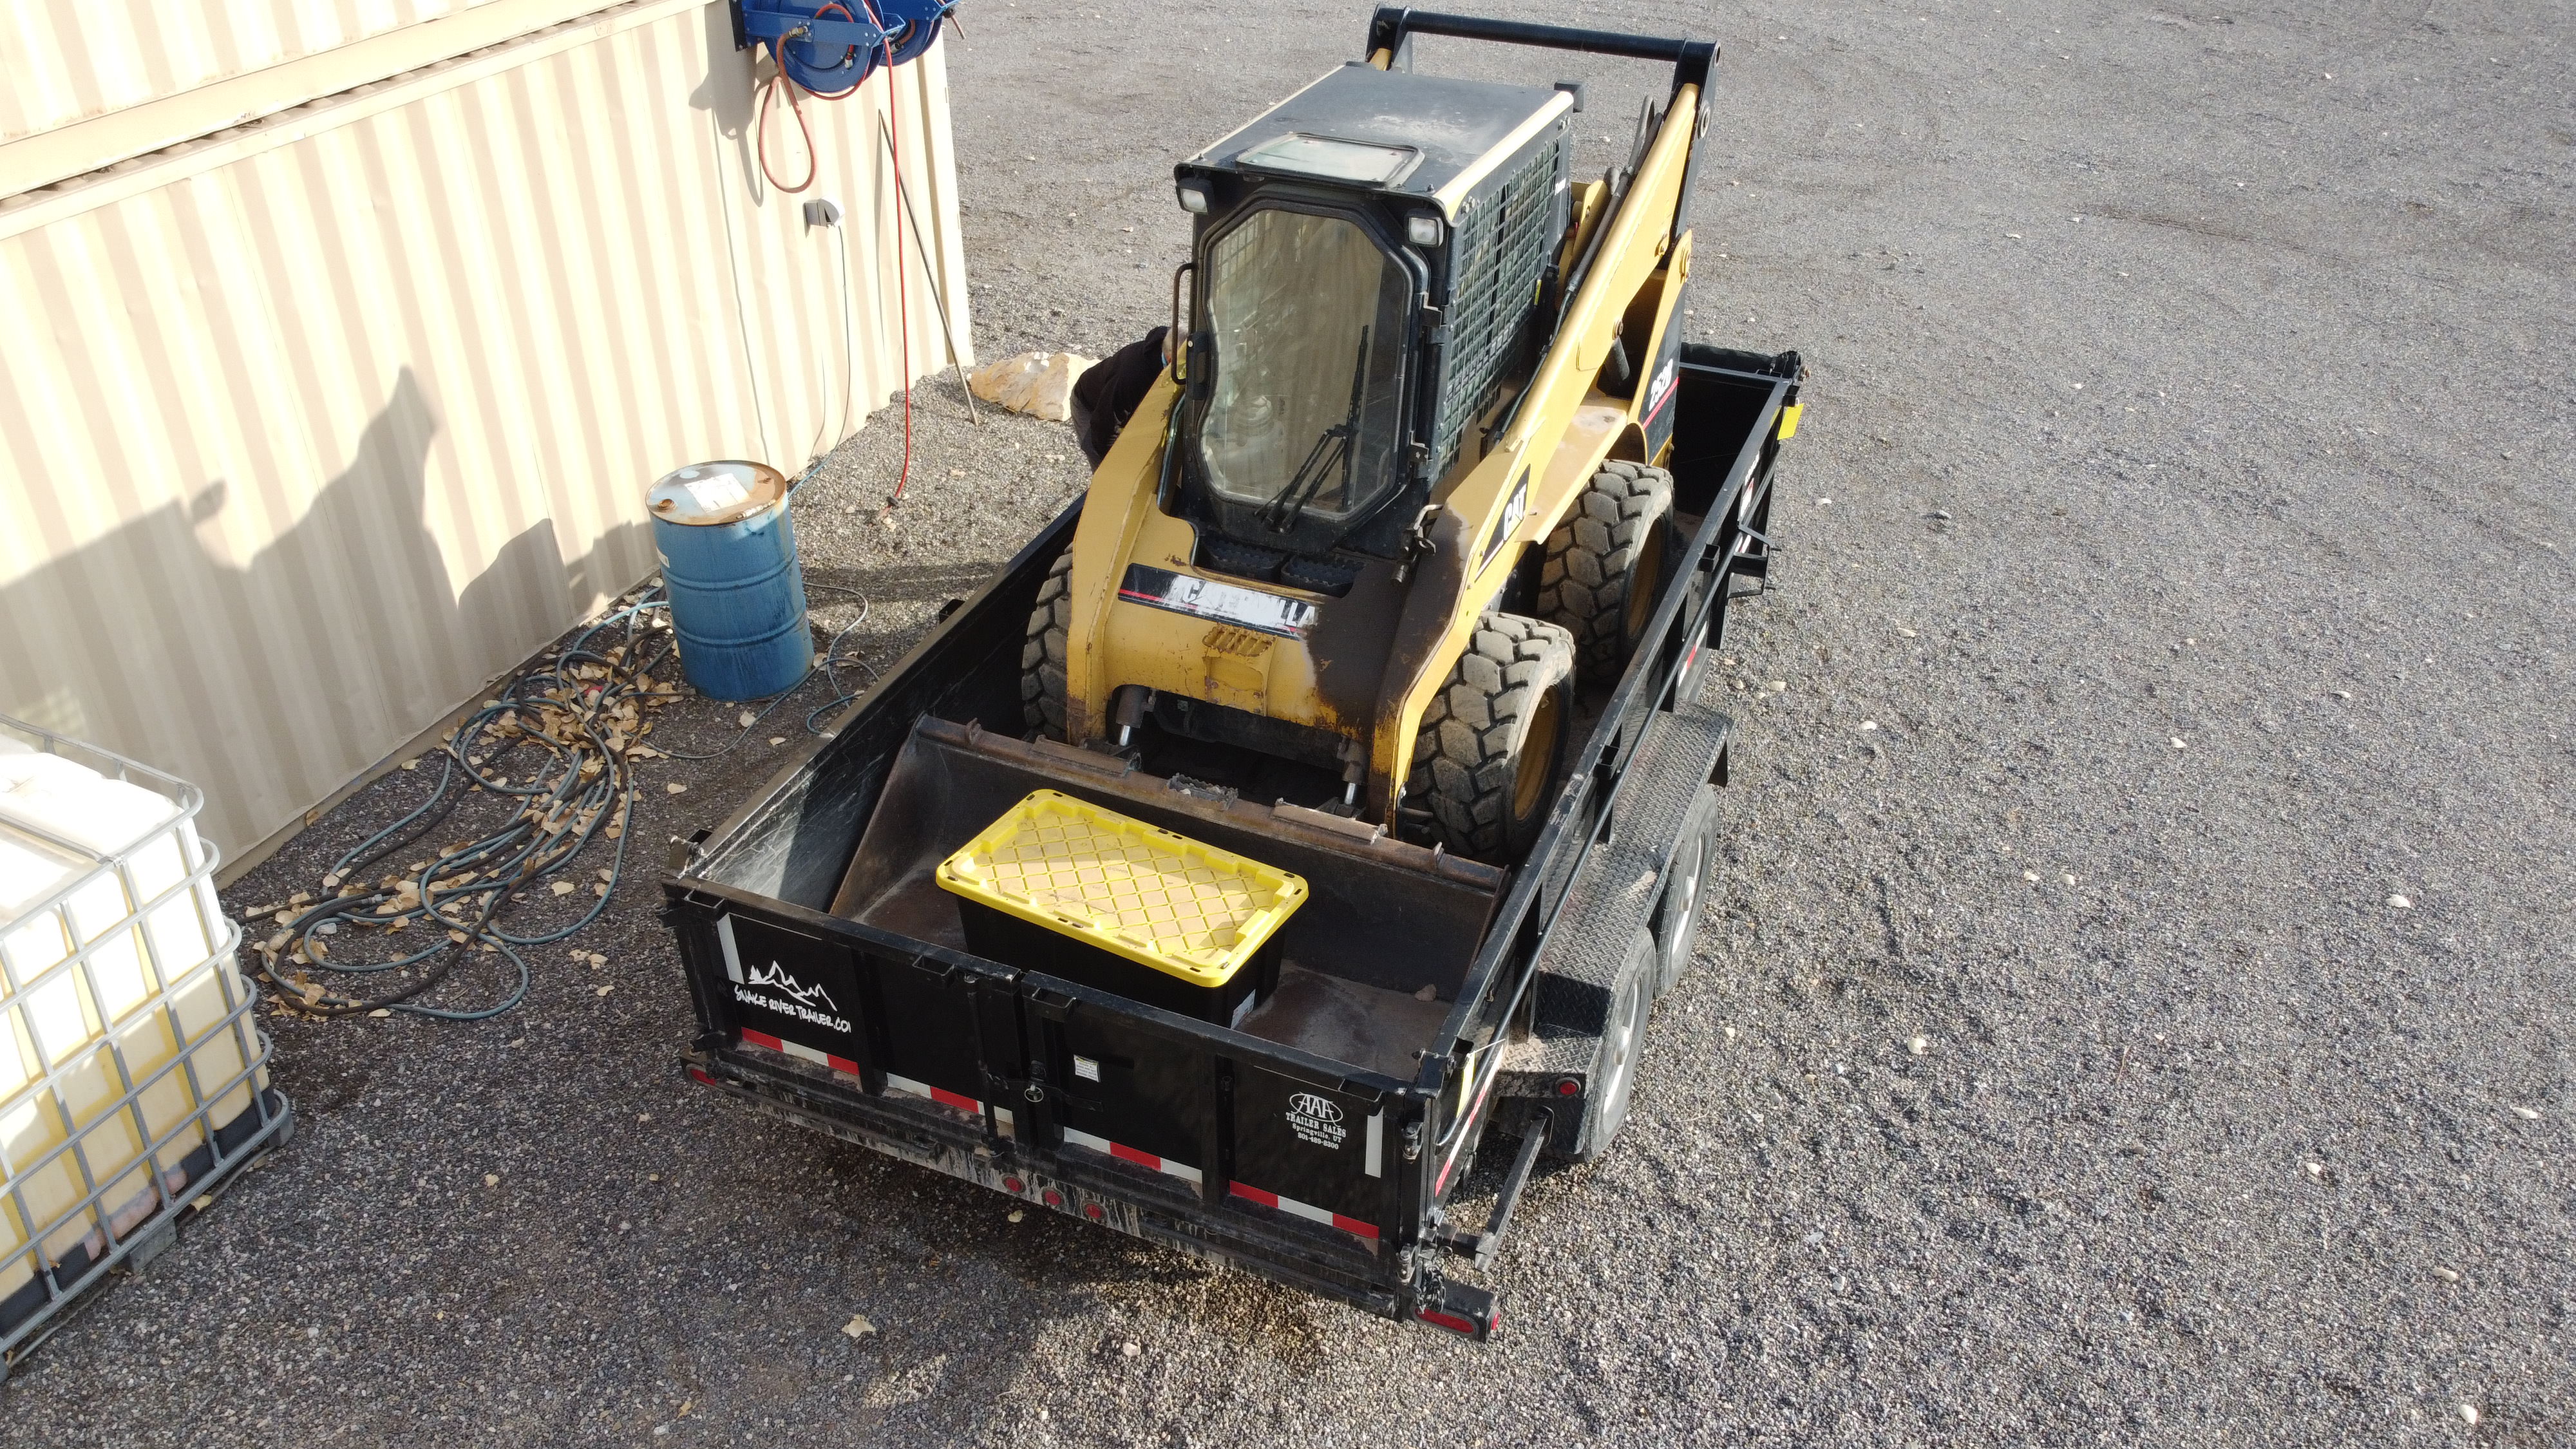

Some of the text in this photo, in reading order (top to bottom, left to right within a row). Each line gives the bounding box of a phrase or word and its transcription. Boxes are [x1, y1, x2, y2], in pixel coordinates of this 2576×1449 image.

[1504, 484, 1527, 540] CAT
[734, 985, 851, 1033] SNAKE RIVER TRAILER.CO
[1291, 1093, 1340, 1124] AAA
[1285, 1112, 1347, 1138] TRAILER SALES
[1292, 1123, 1342, 1143] Springville, UT
